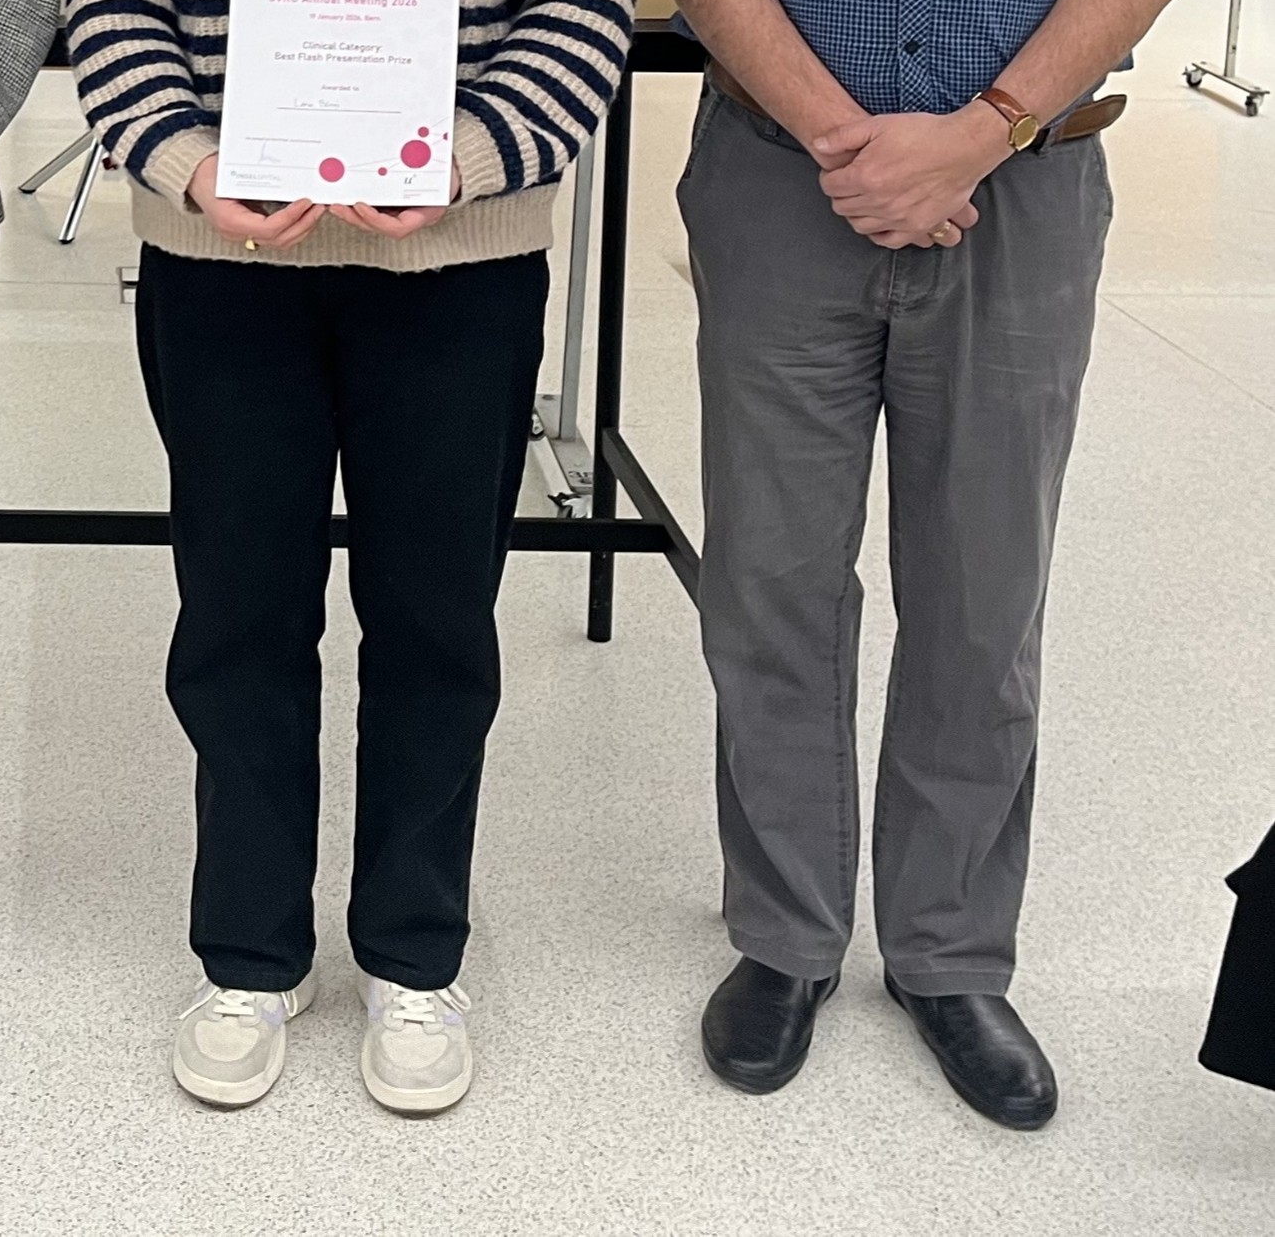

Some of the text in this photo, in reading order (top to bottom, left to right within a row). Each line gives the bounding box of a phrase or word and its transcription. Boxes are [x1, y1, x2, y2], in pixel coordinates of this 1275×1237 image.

[302, 41, 336, 50] Clinical
[274, 52, 412, 64] Best Flash Presentation Prize
